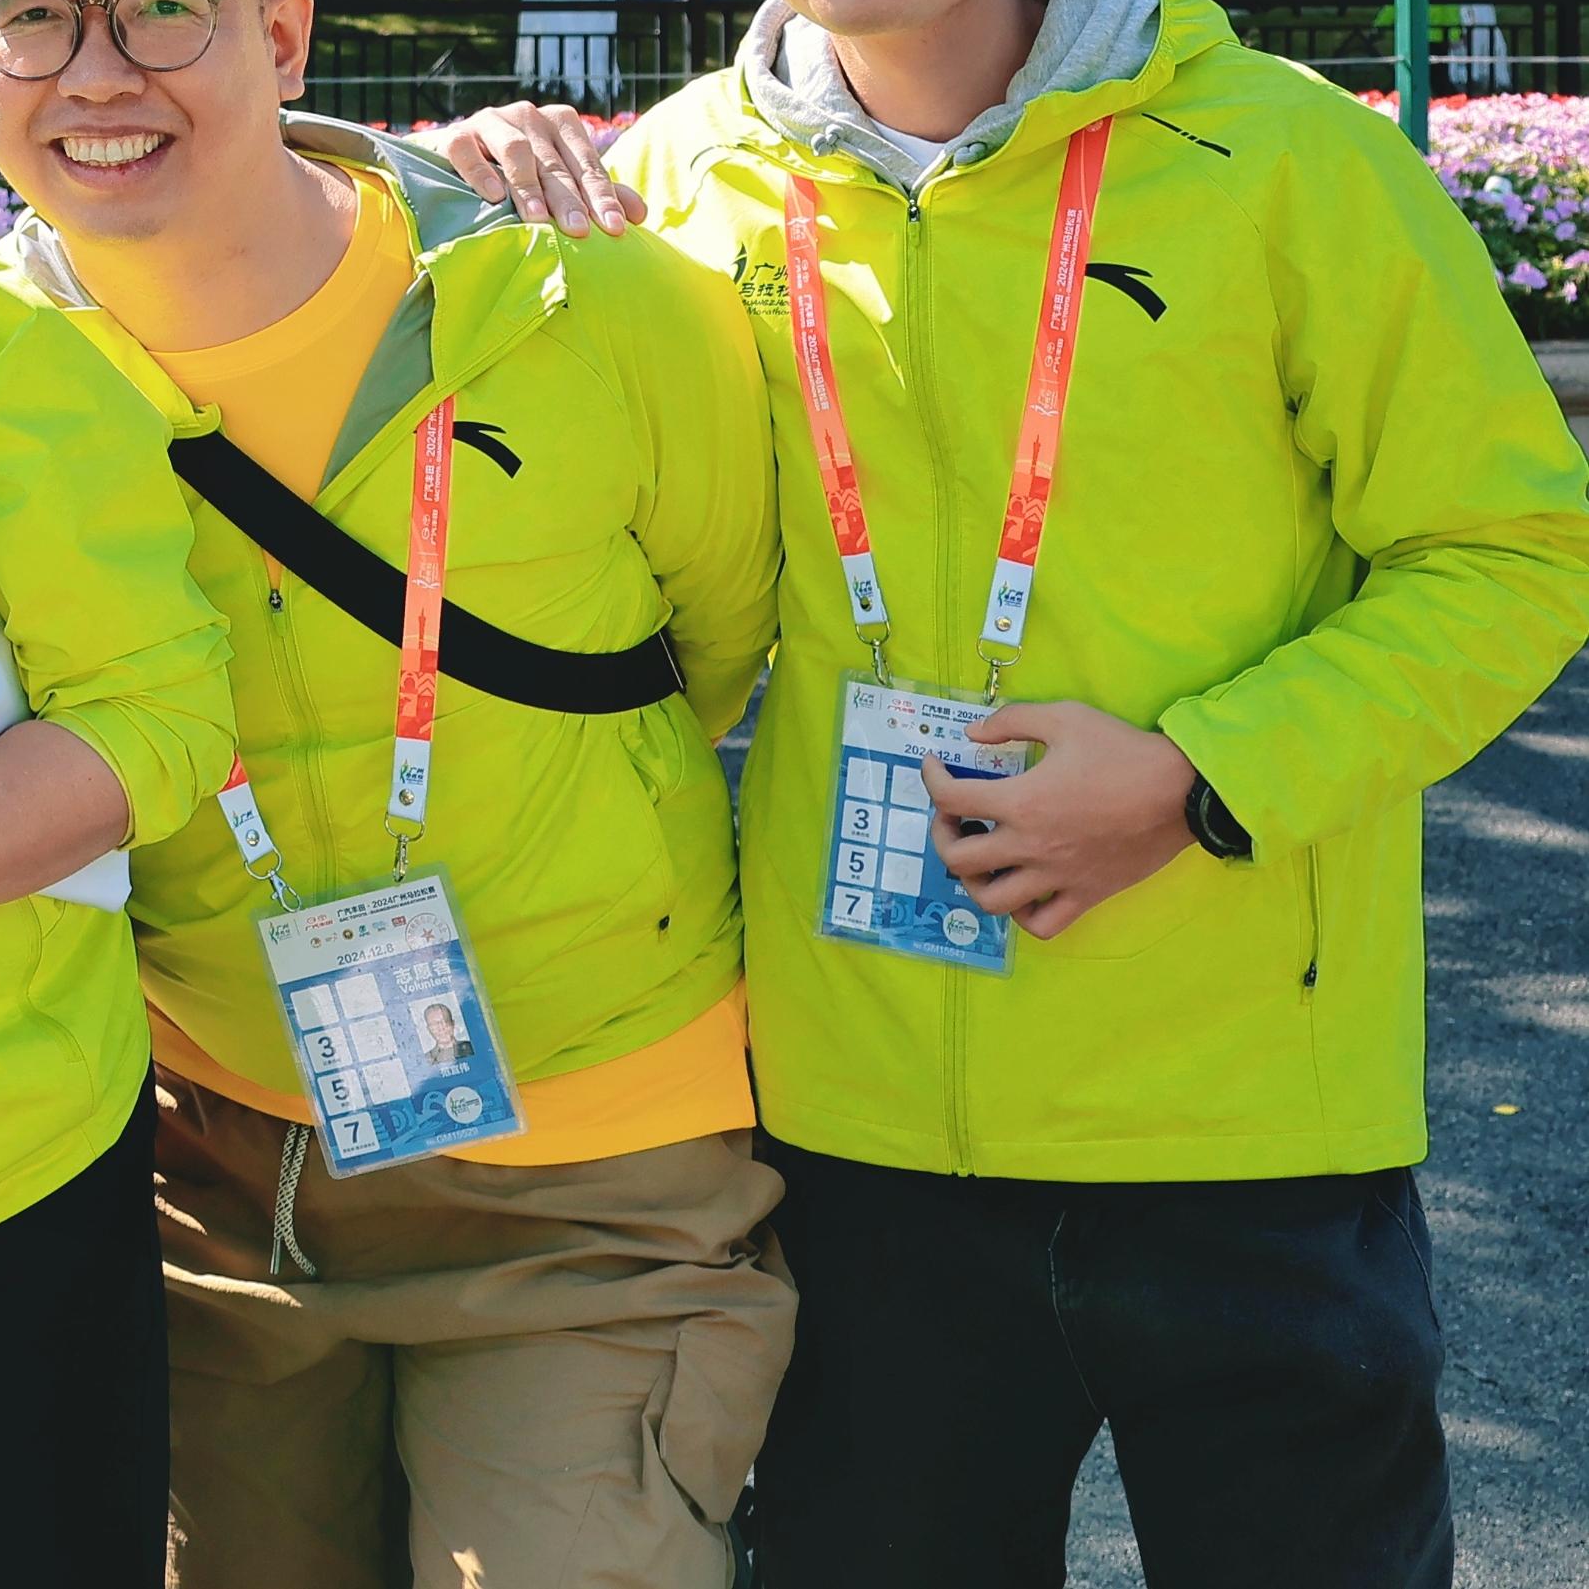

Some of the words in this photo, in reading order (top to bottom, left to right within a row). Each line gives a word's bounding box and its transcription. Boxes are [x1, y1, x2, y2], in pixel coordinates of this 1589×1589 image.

[852, 807, 871, 831] 3
[847, 850, 866, 874] 5
[842, 894, 861, 917] 7
[336, 942, 394, 966] 2024.12.8
[392, 955, 451, 986] 志愿者
[399, 971, 453, 995] Volunteer
[316, 1035, 336, 1059] 3
[330, 1077, 350, 1101] 5
[343, 1120, 364, 1144] 7
